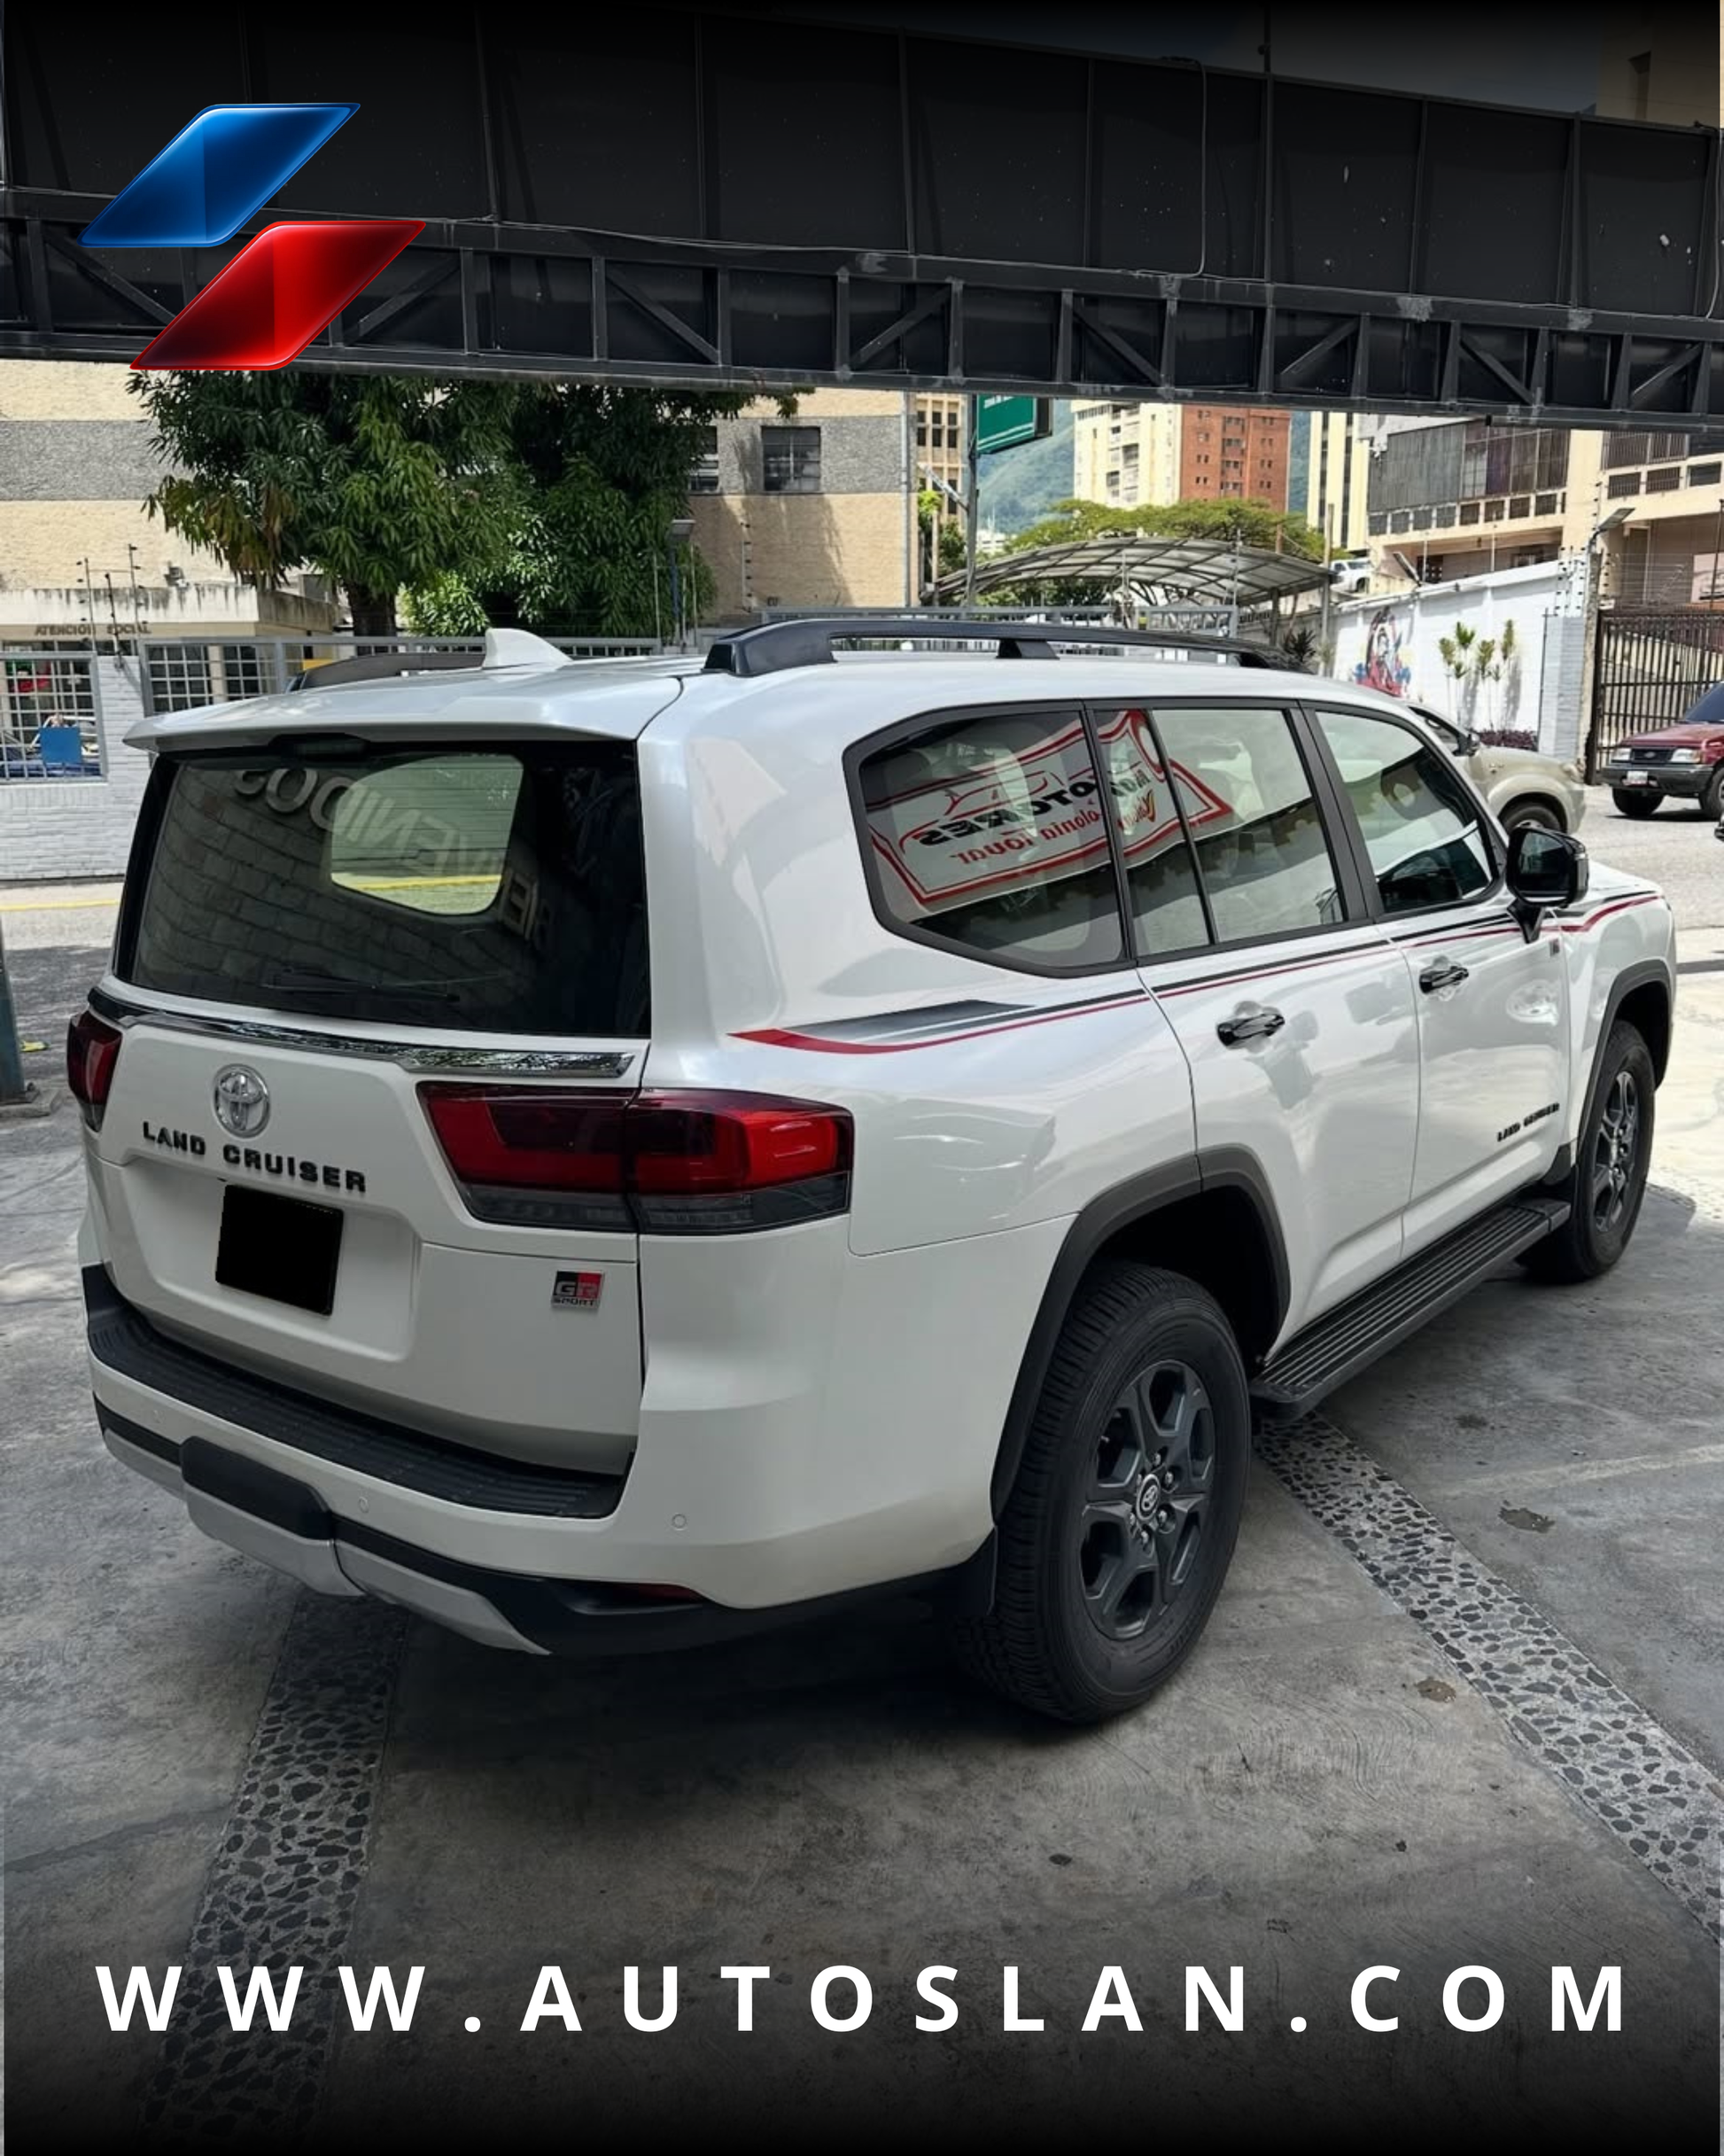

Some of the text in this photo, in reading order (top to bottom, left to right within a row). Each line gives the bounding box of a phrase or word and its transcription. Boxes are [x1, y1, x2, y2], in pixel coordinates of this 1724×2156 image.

[143, 1120, 367, 1193] LAND CRUISER
[555, 1280, 599, 1299] GR
[553, 1296, 595, 1307] SPORT
